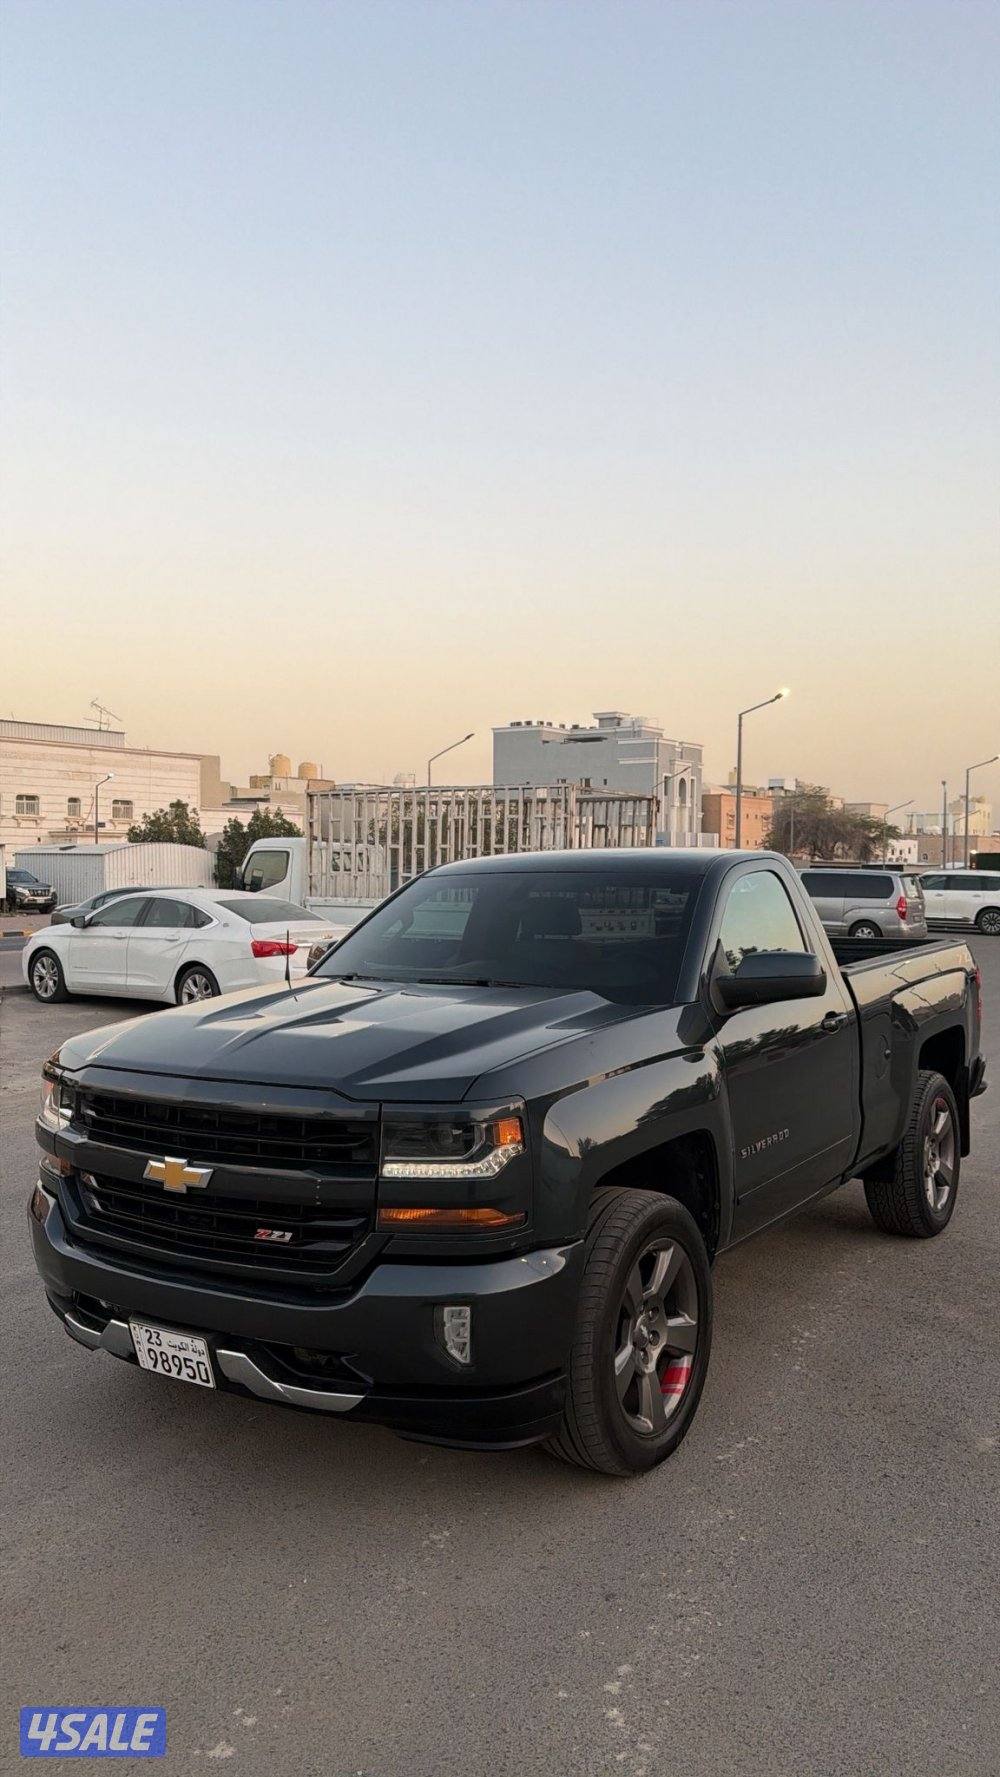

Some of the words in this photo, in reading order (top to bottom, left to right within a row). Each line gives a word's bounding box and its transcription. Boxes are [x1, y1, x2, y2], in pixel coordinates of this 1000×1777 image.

[741, 1128, 790, 1159] SILVERADO
[145, 1328, 162, 1347] 23
[147, 1347, 211, 1384] 98950
